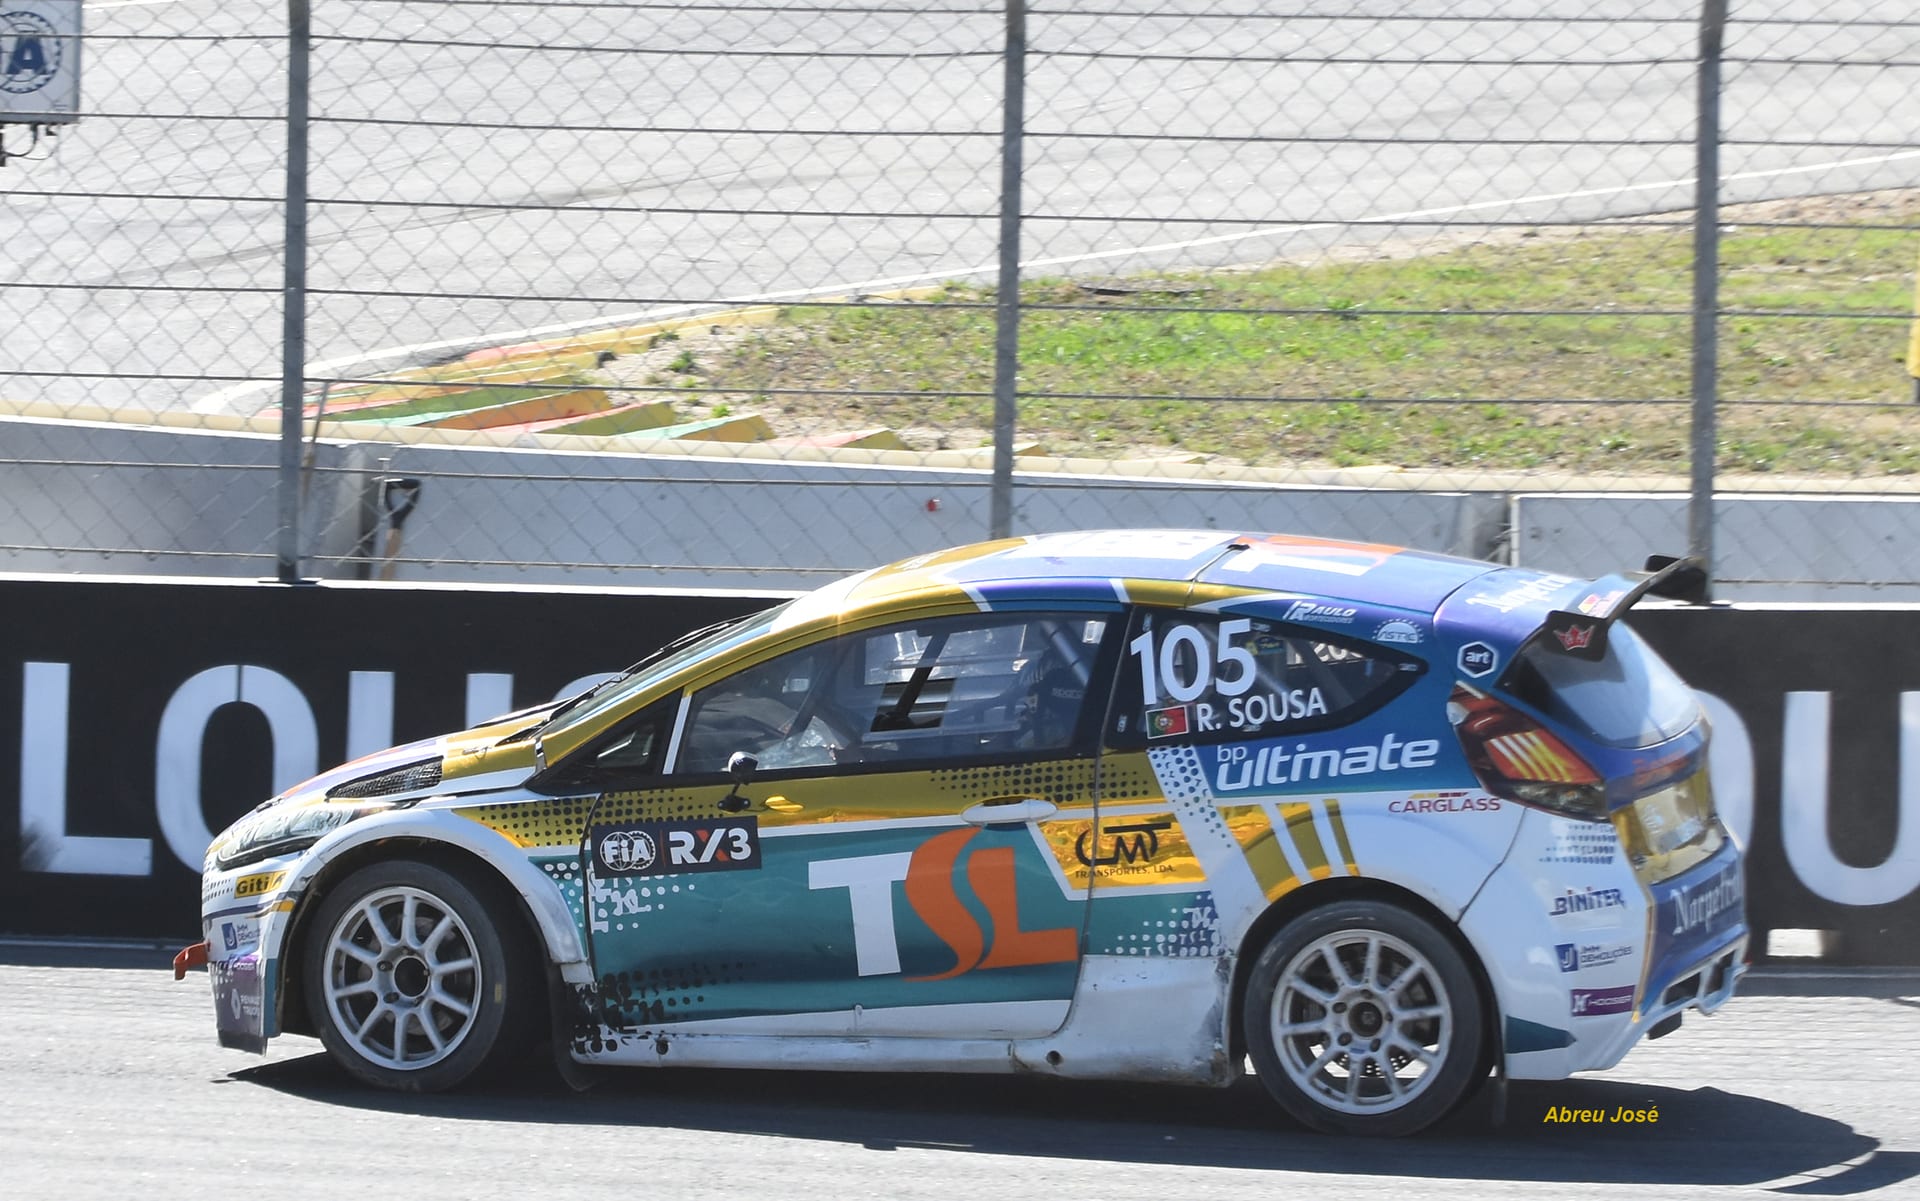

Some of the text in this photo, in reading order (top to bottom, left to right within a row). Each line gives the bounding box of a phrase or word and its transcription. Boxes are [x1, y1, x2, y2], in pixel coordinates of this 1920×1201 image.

[1130, 618, 1256, 705] 105
[1465, 651, 1490, 664] art
[1196, 687, 1327, 732] R. SOUSA
[1216, 744, 1248, 766] bp
[1216, 733, 1440, 791] ultimate
[1388, 798, 1502, 813] CARGLASS
[236, 875, 270, 895] Giti
[808, 826, 1079, 983] TSL
